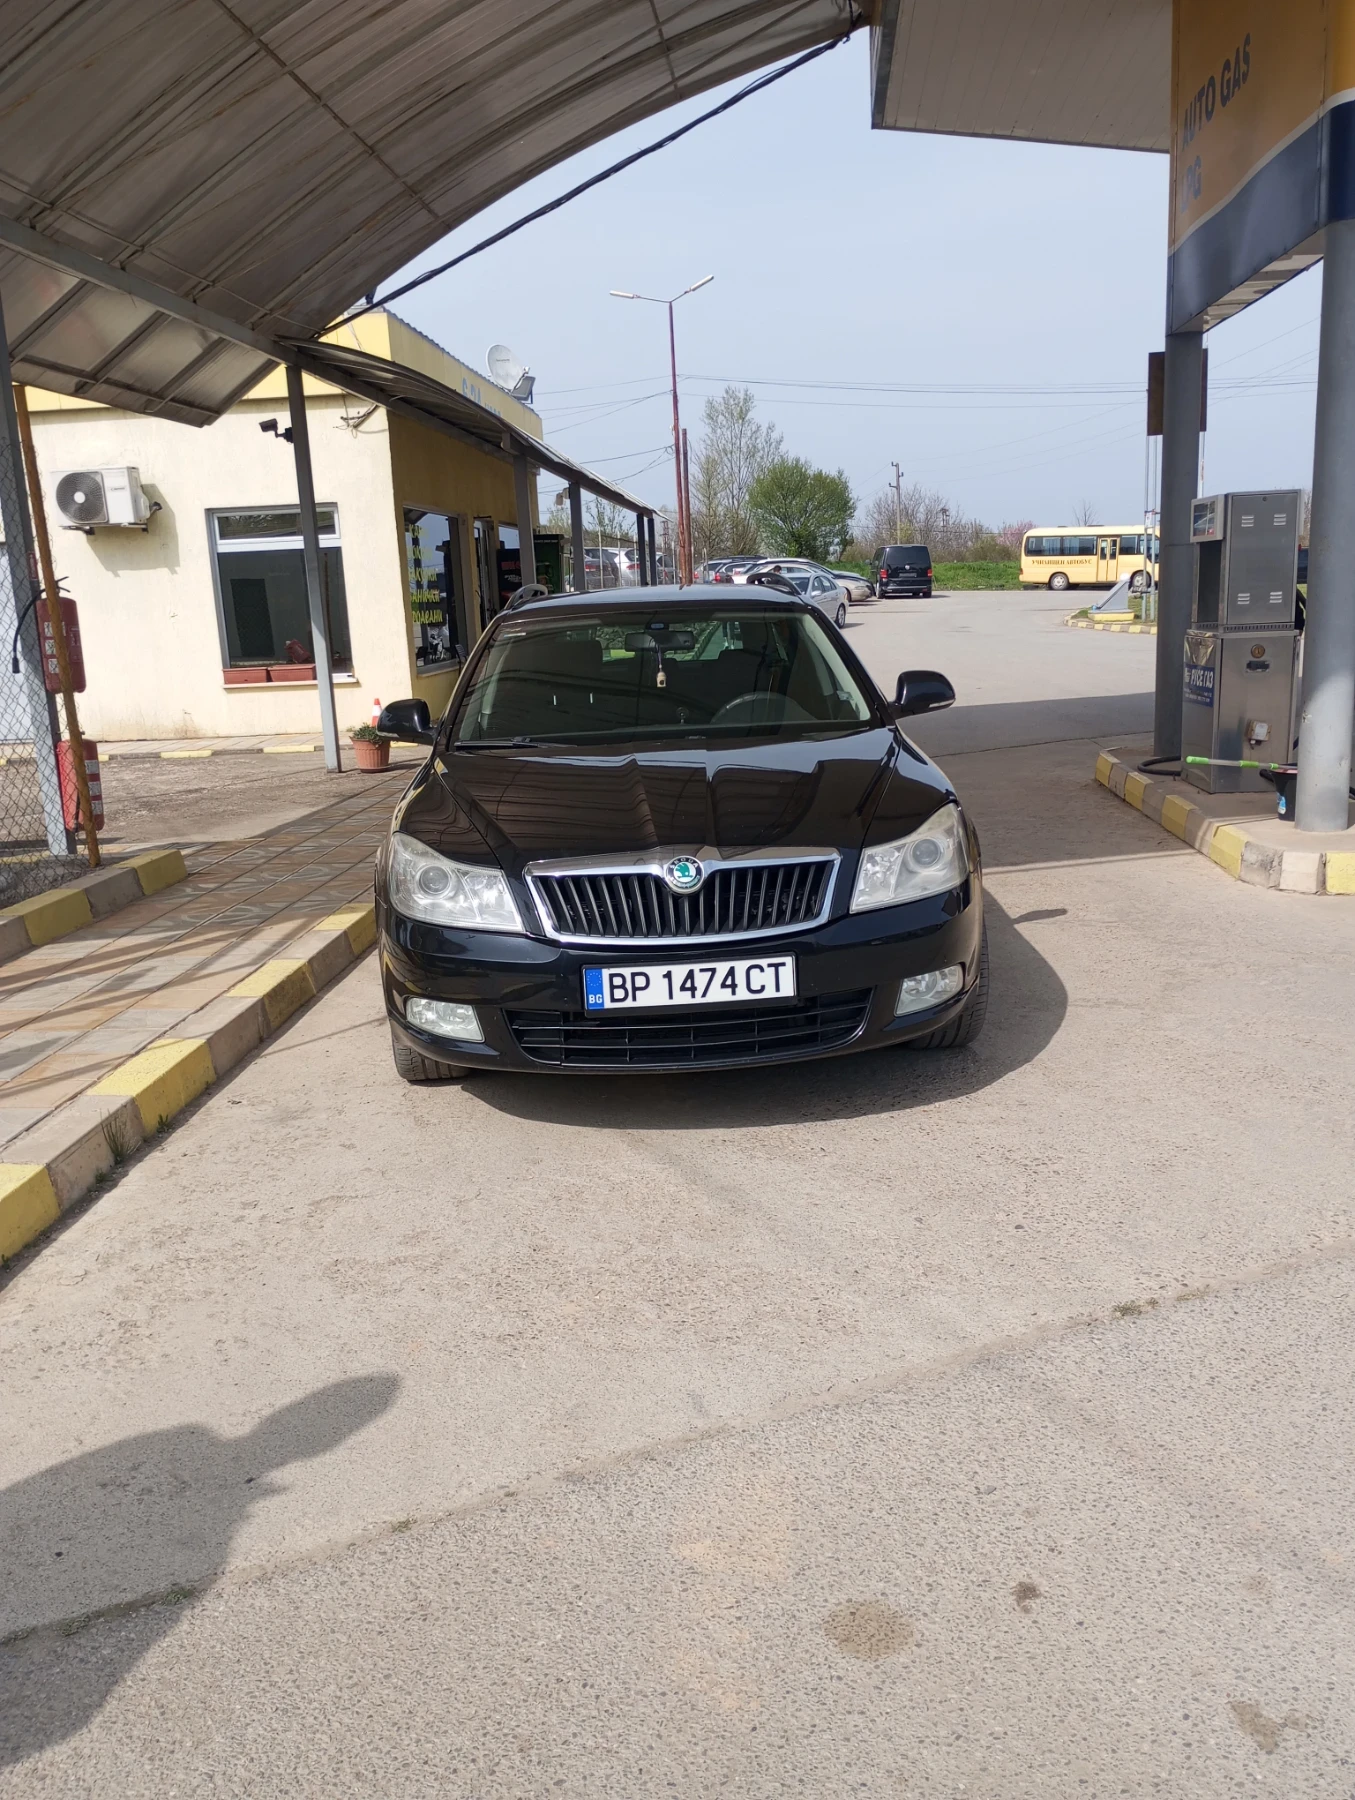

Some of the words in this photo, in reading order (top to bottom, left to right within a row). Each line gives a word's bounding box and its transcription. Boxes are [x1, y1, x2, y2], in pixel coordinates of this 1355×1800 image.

[1181, 75, 1217, 152] AUTO
[1219, 32, 1251, 108] GAS
[1179, 155, 1202, 215] LPG
[1203, 670, 1214, 689] ГАЗ
[588, 993, 603, 1004] BG
[608, 971, 651, 1003] BP
[662, 965, 738, 1000] 1474
[745, 962, 787, 994] CT
